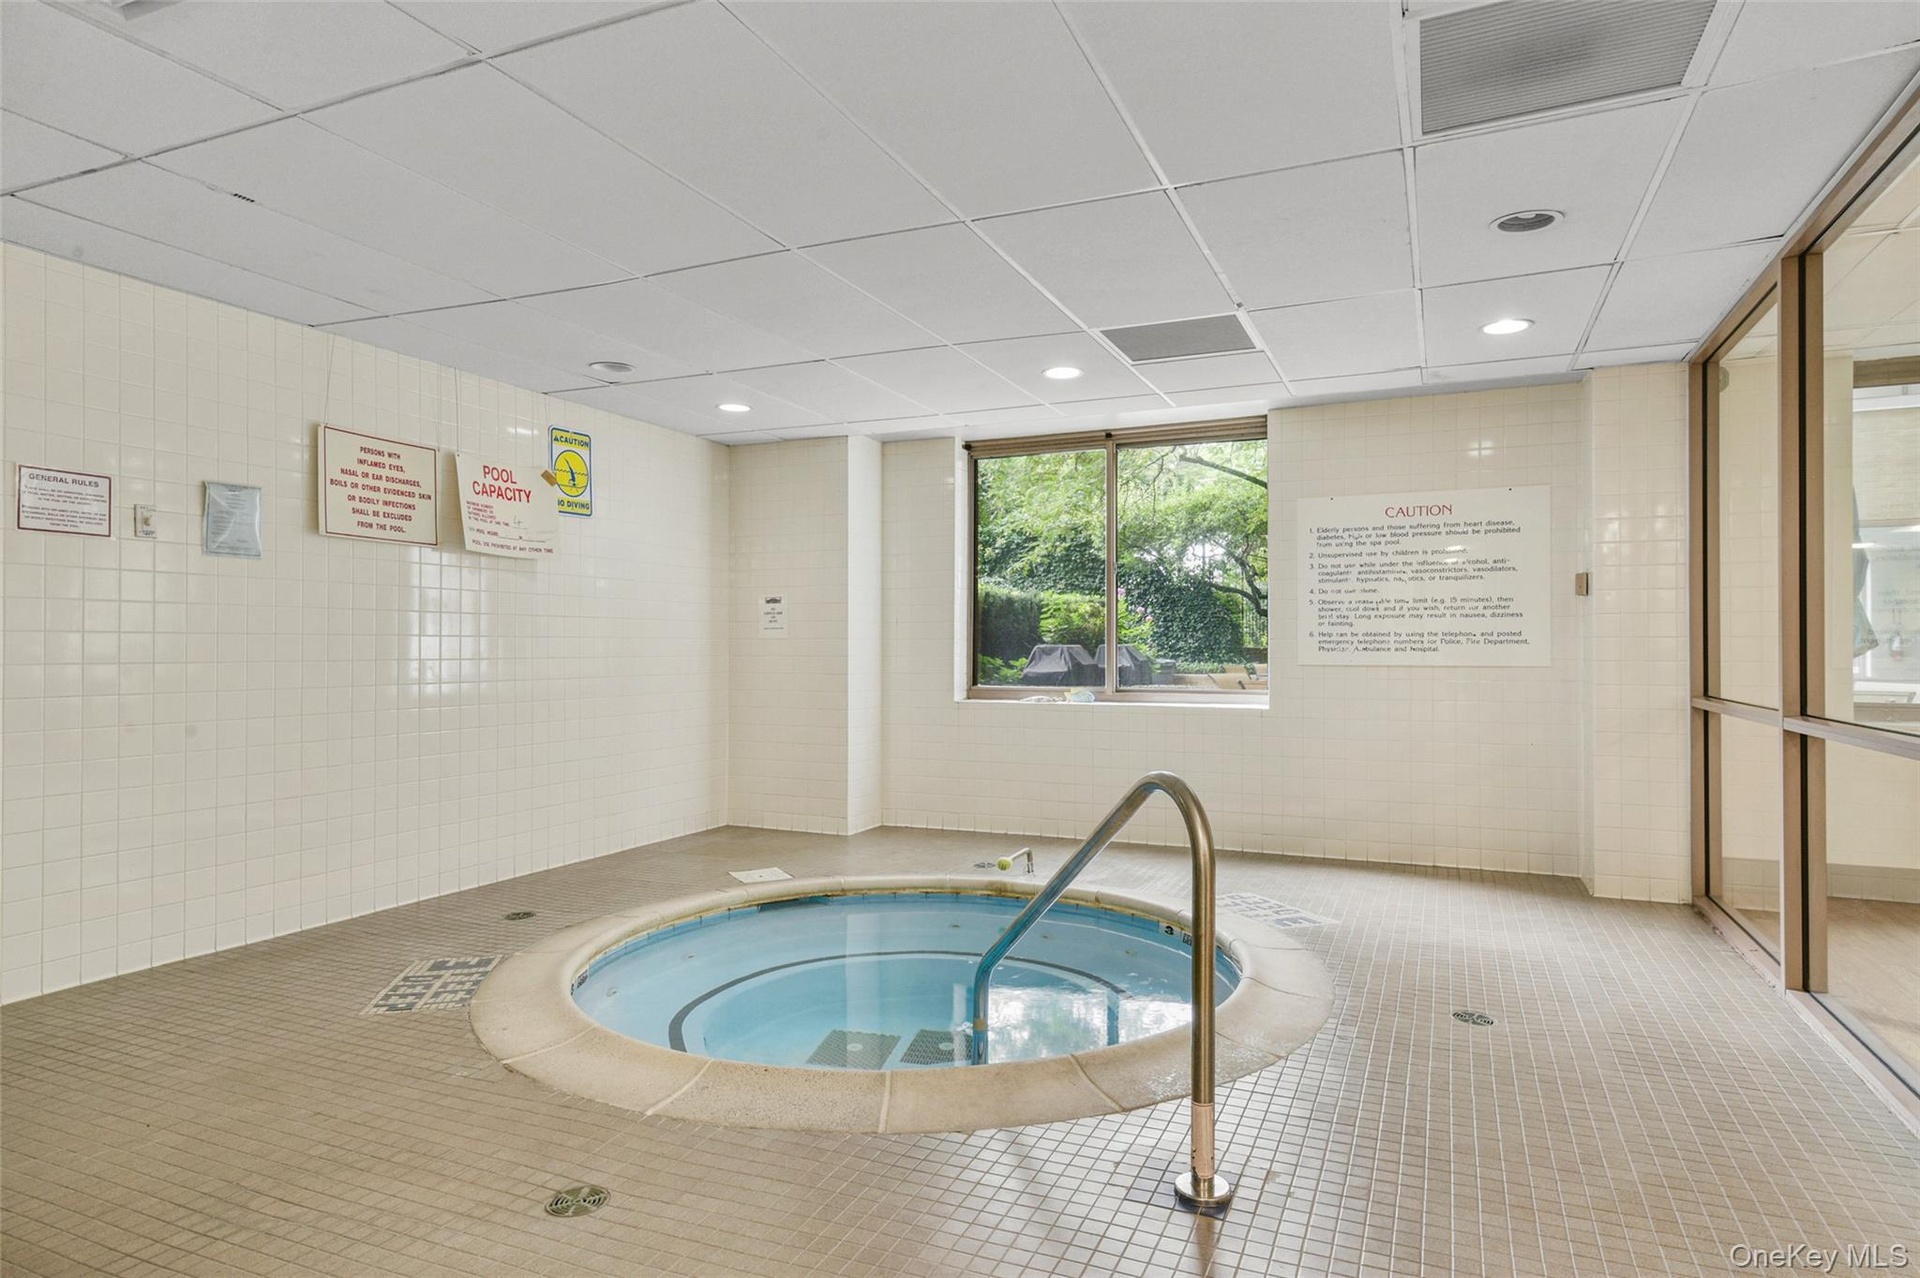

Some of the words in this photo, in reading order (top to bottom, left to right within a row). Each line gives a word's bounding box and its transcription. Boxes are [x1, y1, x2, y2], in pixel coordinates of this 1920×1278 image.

[559, 436, 589, 448] CAUTION
[360, 446, 385, 458] PERSONS
[387, 452, 401, 460] WITH
[357, 458, 386, 469] INFLAMED
[389, 464, 406, 473] EYES,
[28, 473, 70, 484] GENERAL
[71, 478, 99, 488] RULES
[340, 468, 359, 477] NASAL
[372, 473, 383, 481] EAR
[385, 476, 422, 488] DISCHARGES,
[482, 465, 517, 485] POOL
[330, 478, 348, 488] BOILS
[361, 484, 381, 493] OTHER
[383, 488, 416, 498] EVIDENCED
[472, 480, 532, 503] CAPACITY
[382, 500, 416, 510] INFECTIONS
[566, 500, 590, 510] DIVING
[1385, 504, 1453, 518] CAUTION
[352, 507, 370, 516] SHALL
[383, 511, 413, 521] EXCLUDED
[357, 521, 373, 529] FROM
[376, 523, 387, 531] THE
[1316, 527, 1339, 535] Elderly
[1342, 526, 1369, 534] persons
[1409, 522, 1440, 530] suffering
[1411, 530, 1442, 538] pressure
[1484, 527, 1521, 535] prohibited
[1318, 551, 1363, 559] Unsupervised
[1318, 631, 1333, 639] Help
[1497, 630, 1522, 638] posted
[1164, 925, 1175, 936] 3
